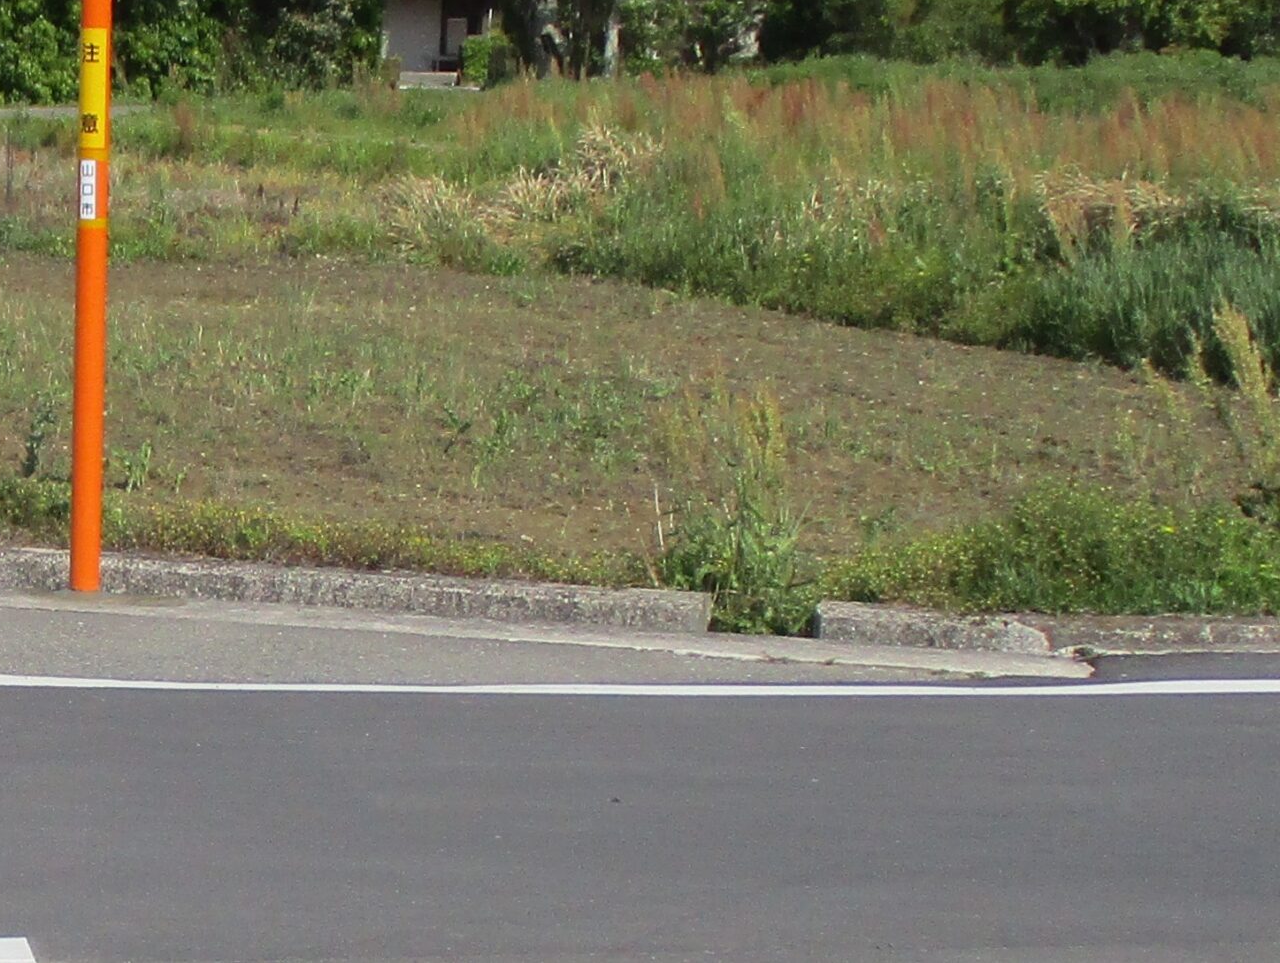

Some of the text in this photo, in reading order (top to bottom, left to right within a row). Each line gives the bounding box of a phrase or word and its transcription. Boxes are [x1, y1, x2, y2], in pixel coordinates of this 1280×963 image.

[81, 43, 99, 133] 注意
[82, 164, 94, 215] 山口市
